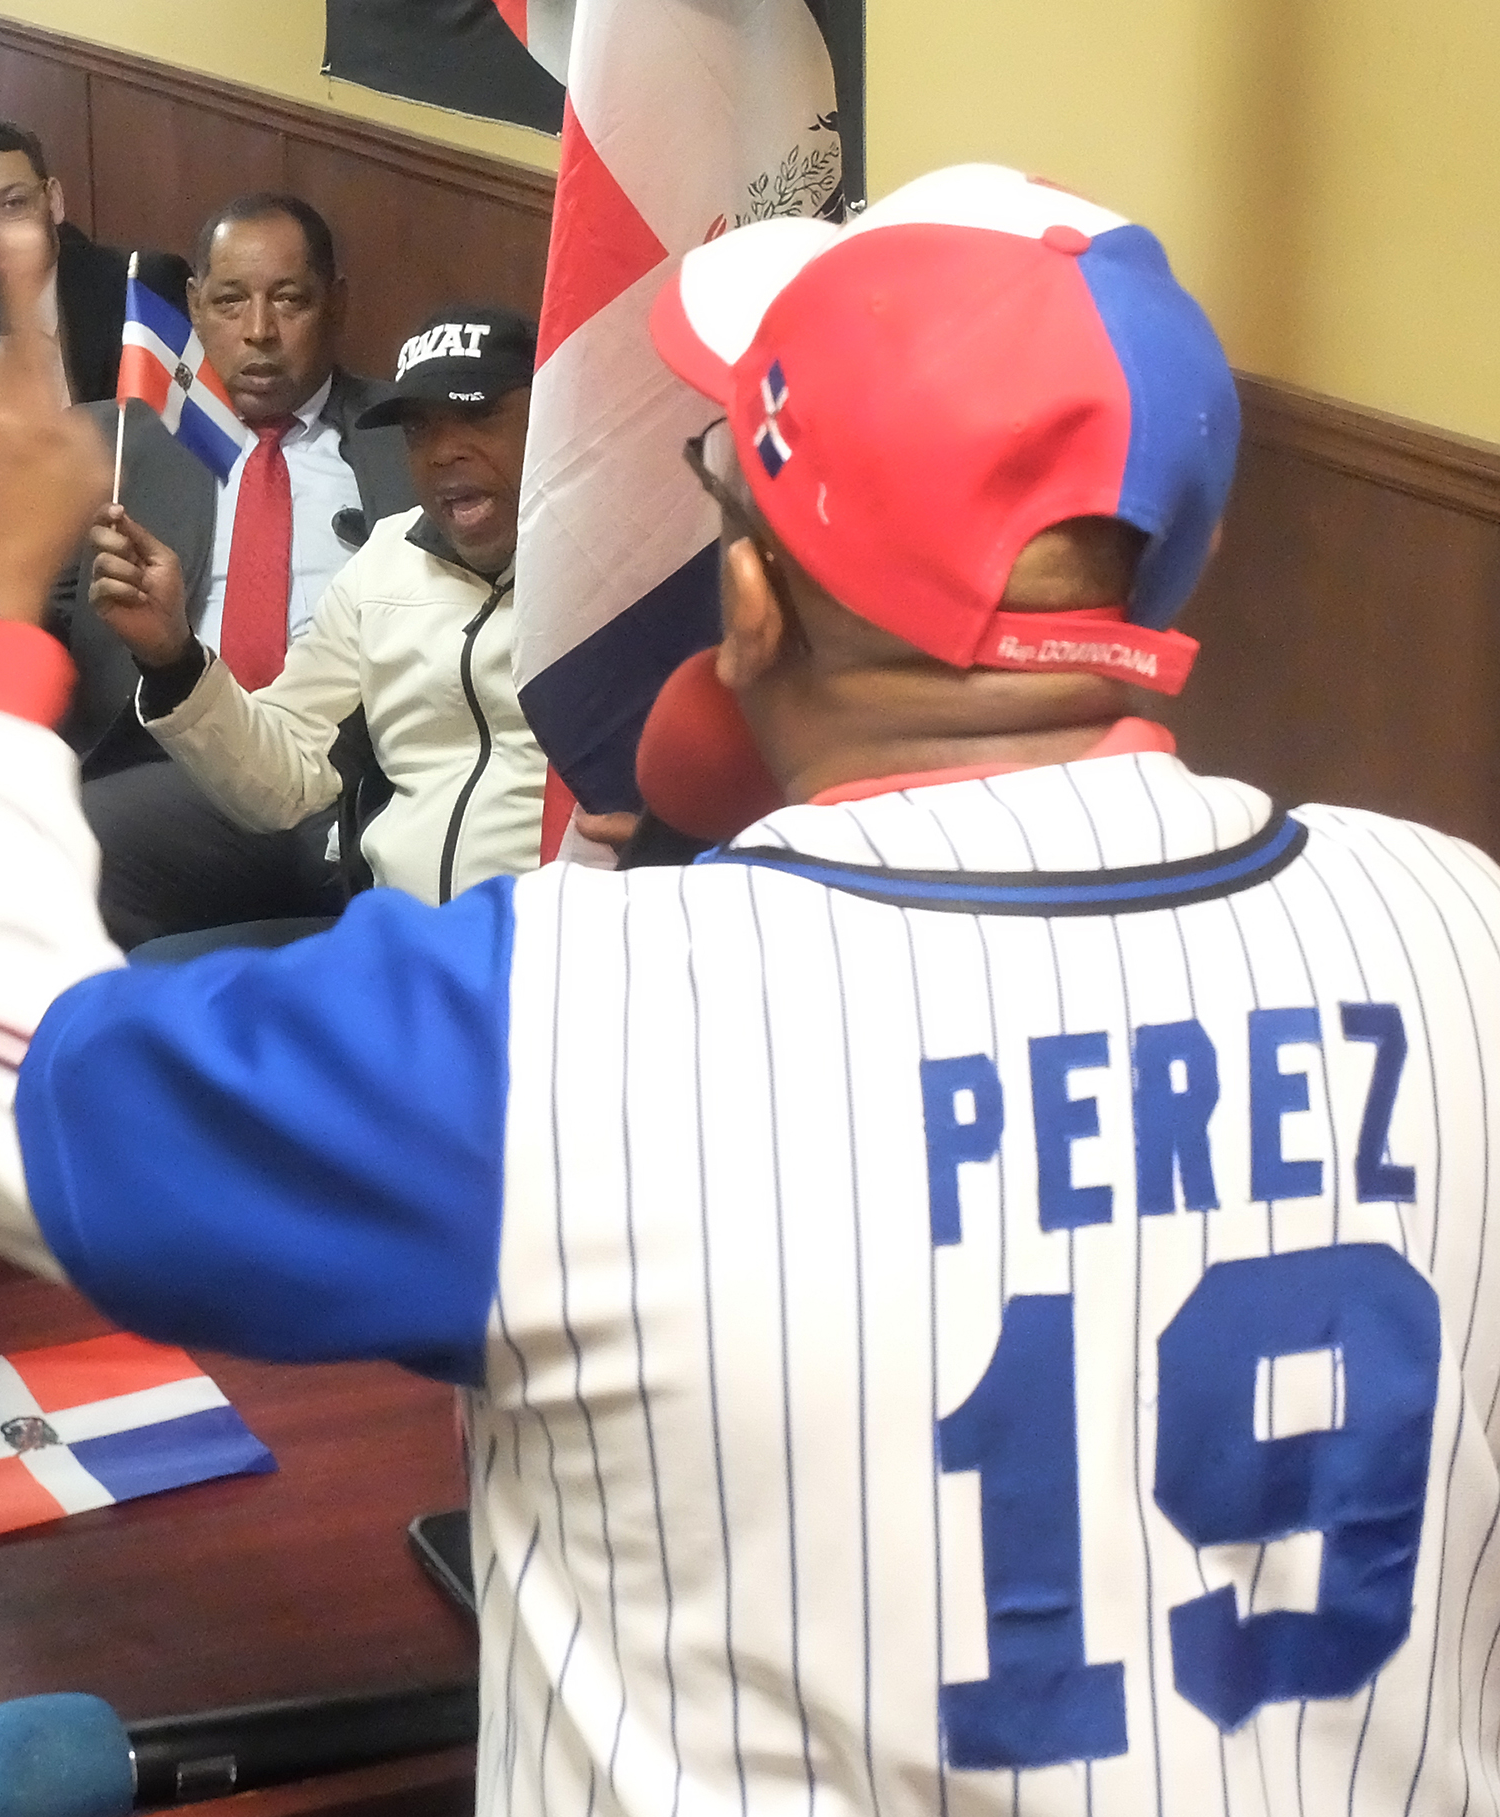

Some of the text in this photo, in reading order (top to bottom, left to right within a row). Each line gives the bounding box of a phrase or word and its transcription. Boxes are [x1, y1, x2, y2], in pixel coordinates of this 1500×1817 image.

[395, 323, 491, 382] SWAT
[920, 1001, 1417, 1246] PEREZ
[935, 1242, 1441, 1770] 19
